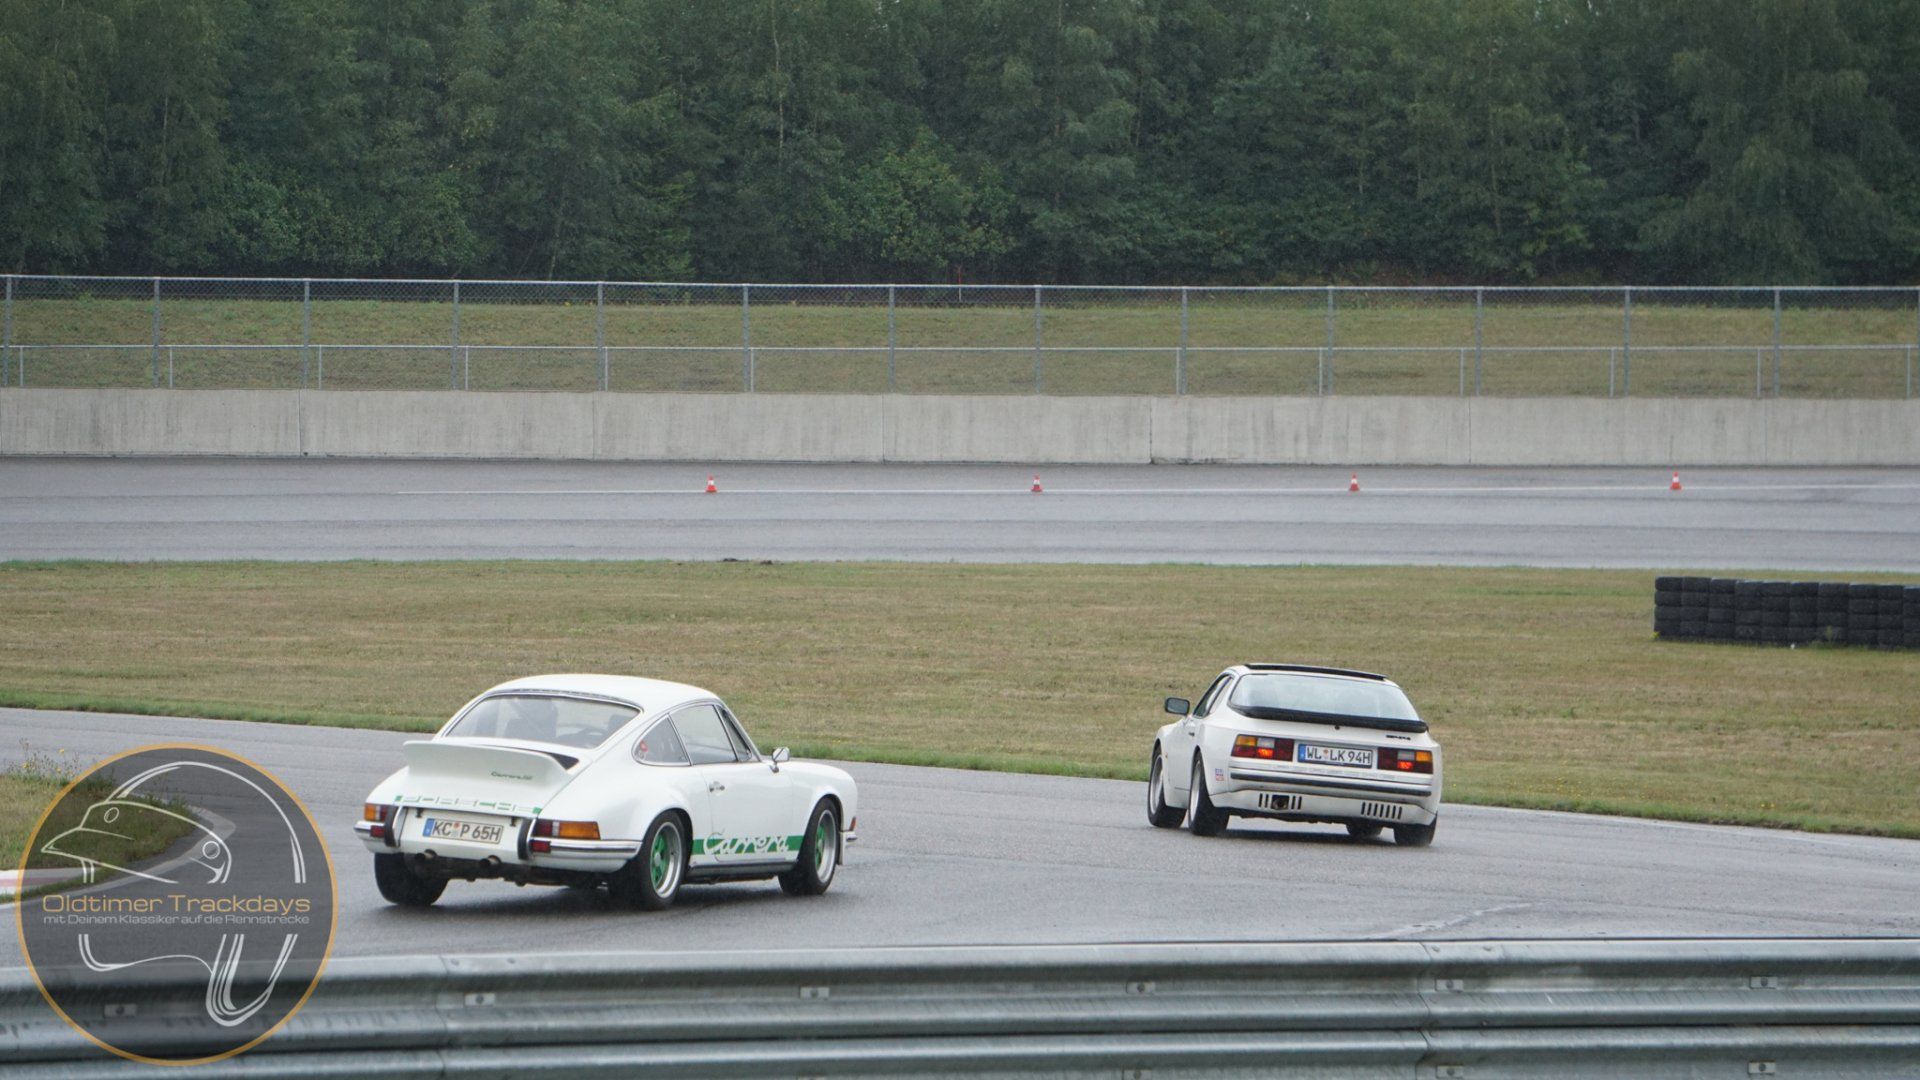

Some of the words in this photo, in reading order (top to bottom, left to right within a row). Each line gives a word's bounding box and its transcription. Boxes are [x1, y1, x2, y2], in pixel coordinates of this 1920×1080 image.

[1306, 746, 1322, 760] WL
[1330, 749, 1345, 762] LK
[1348, 750, 1371, 764] 94H
[432, 820, 452, 836] KC
[459, 824, 470, 837] P
[471, 825, 501, 841] 65H
[703, 831, 789, 855] Carrera
